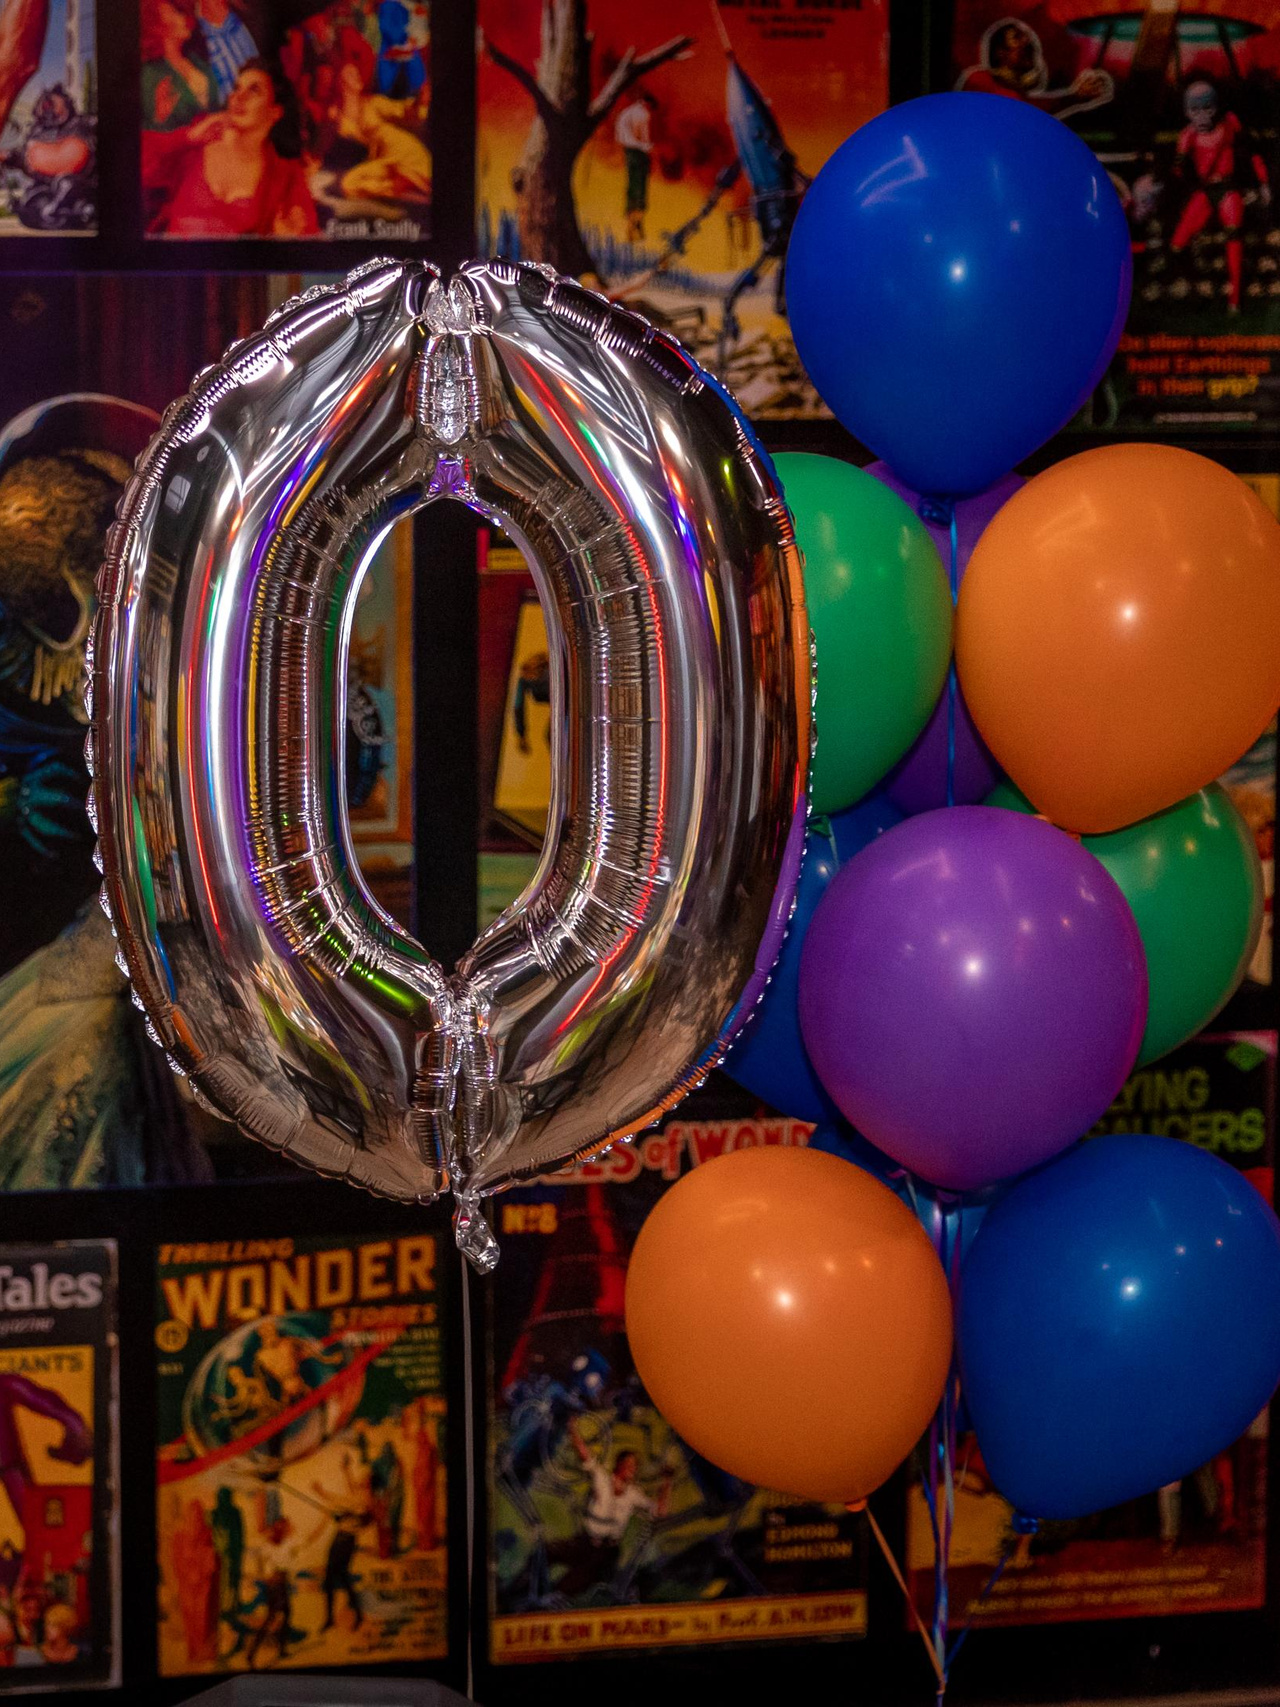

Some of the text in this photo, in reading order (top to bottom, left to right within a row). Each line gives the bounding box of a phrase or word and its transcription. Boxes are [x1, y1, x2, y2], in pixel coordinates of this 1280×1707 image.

[158, 1237, 294, 1265] THRILLING
[161, 1234, 437, 1331] WONDER
[503, 1624, 551, 1646] LIFE
[559, 1621, 592, 1641] ON
